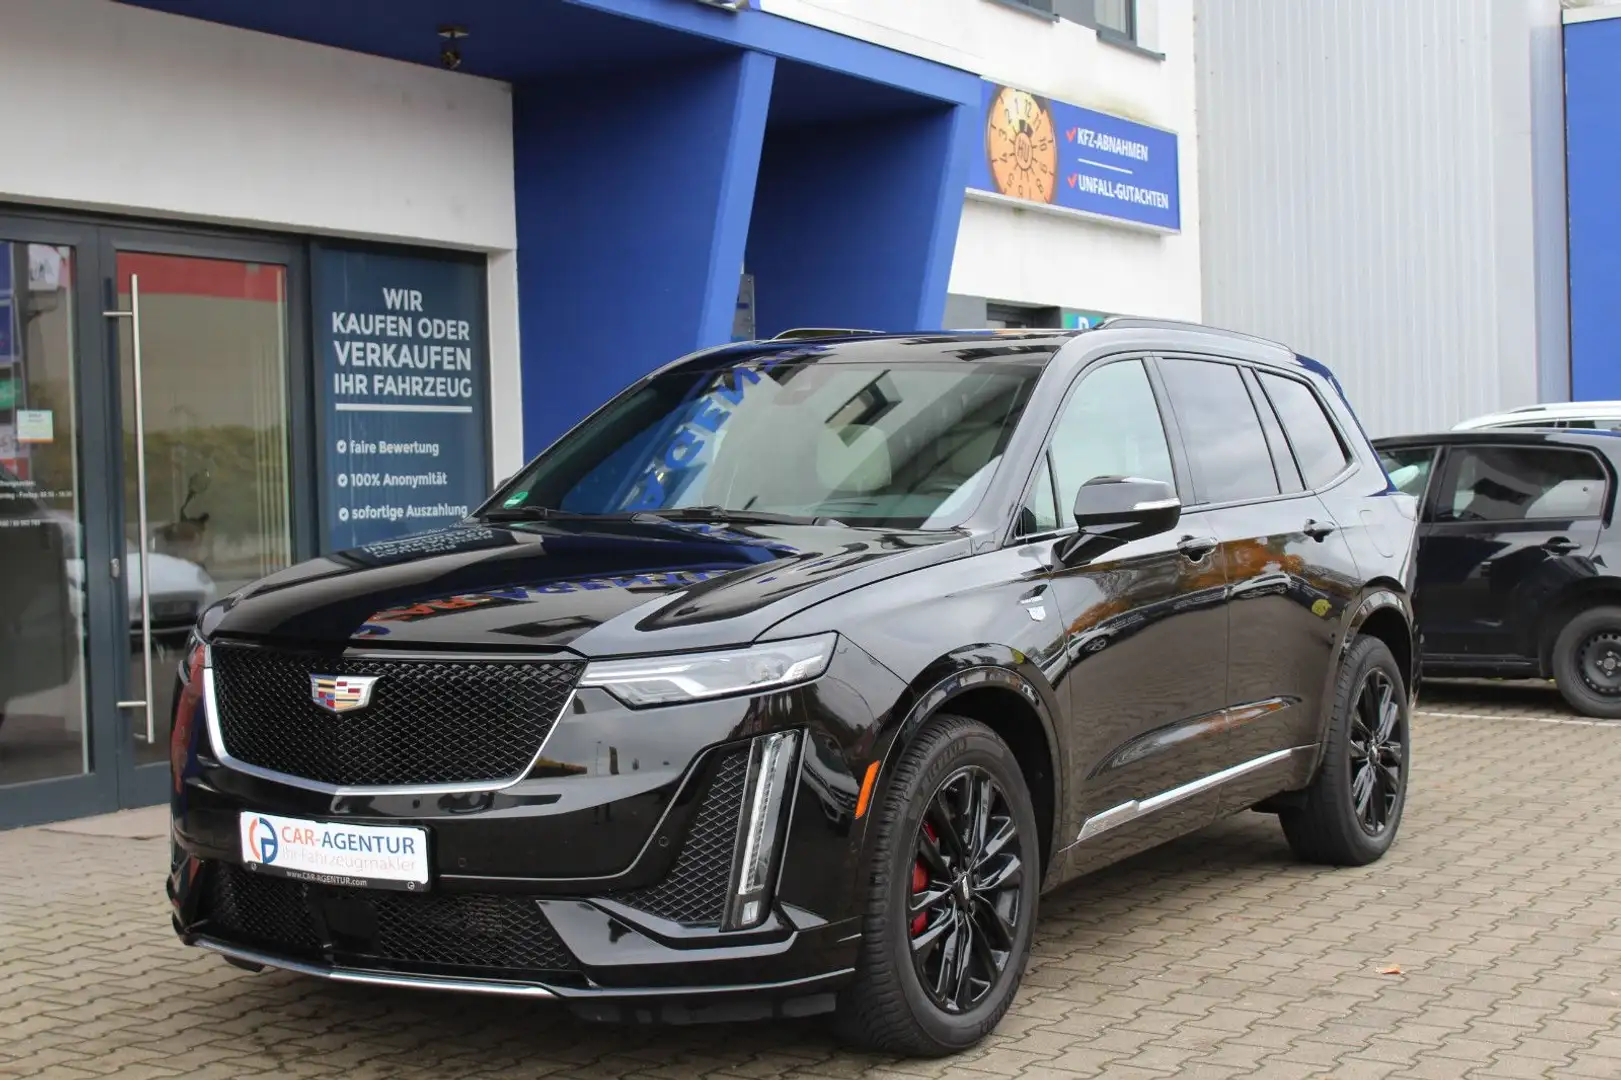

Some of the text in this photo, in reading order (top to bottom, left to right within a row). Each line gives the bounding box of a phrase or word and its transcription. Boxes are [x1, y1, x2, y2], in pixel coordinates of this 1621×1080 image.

[1077, 127, 1149, 162] KFZ-ABNAHMEN
[1078, 174, 1169, 209] UNFALL-GUTACHTEN
[382, 287, 423, 312] WIR
[332, 312, 470, 340] KAUFEN ODER
[333, 340, 472, 371] VERKAUFEN
[334, 373, 472, 398] IHR FAHRZEUG
[350, 440, 440, 456] faire Bewertung
[351, 472, 448, 488] 100% Anonymität
[352, 503, 468, 521] sofortige Auszahlung
[281, 826, 416, 855] CAR-AGENTUR
[281, 846, 416, 872] Ihr Fahrzeugmakler
[286, 870, 368, 887] www.CAR-AGENTUR.com
